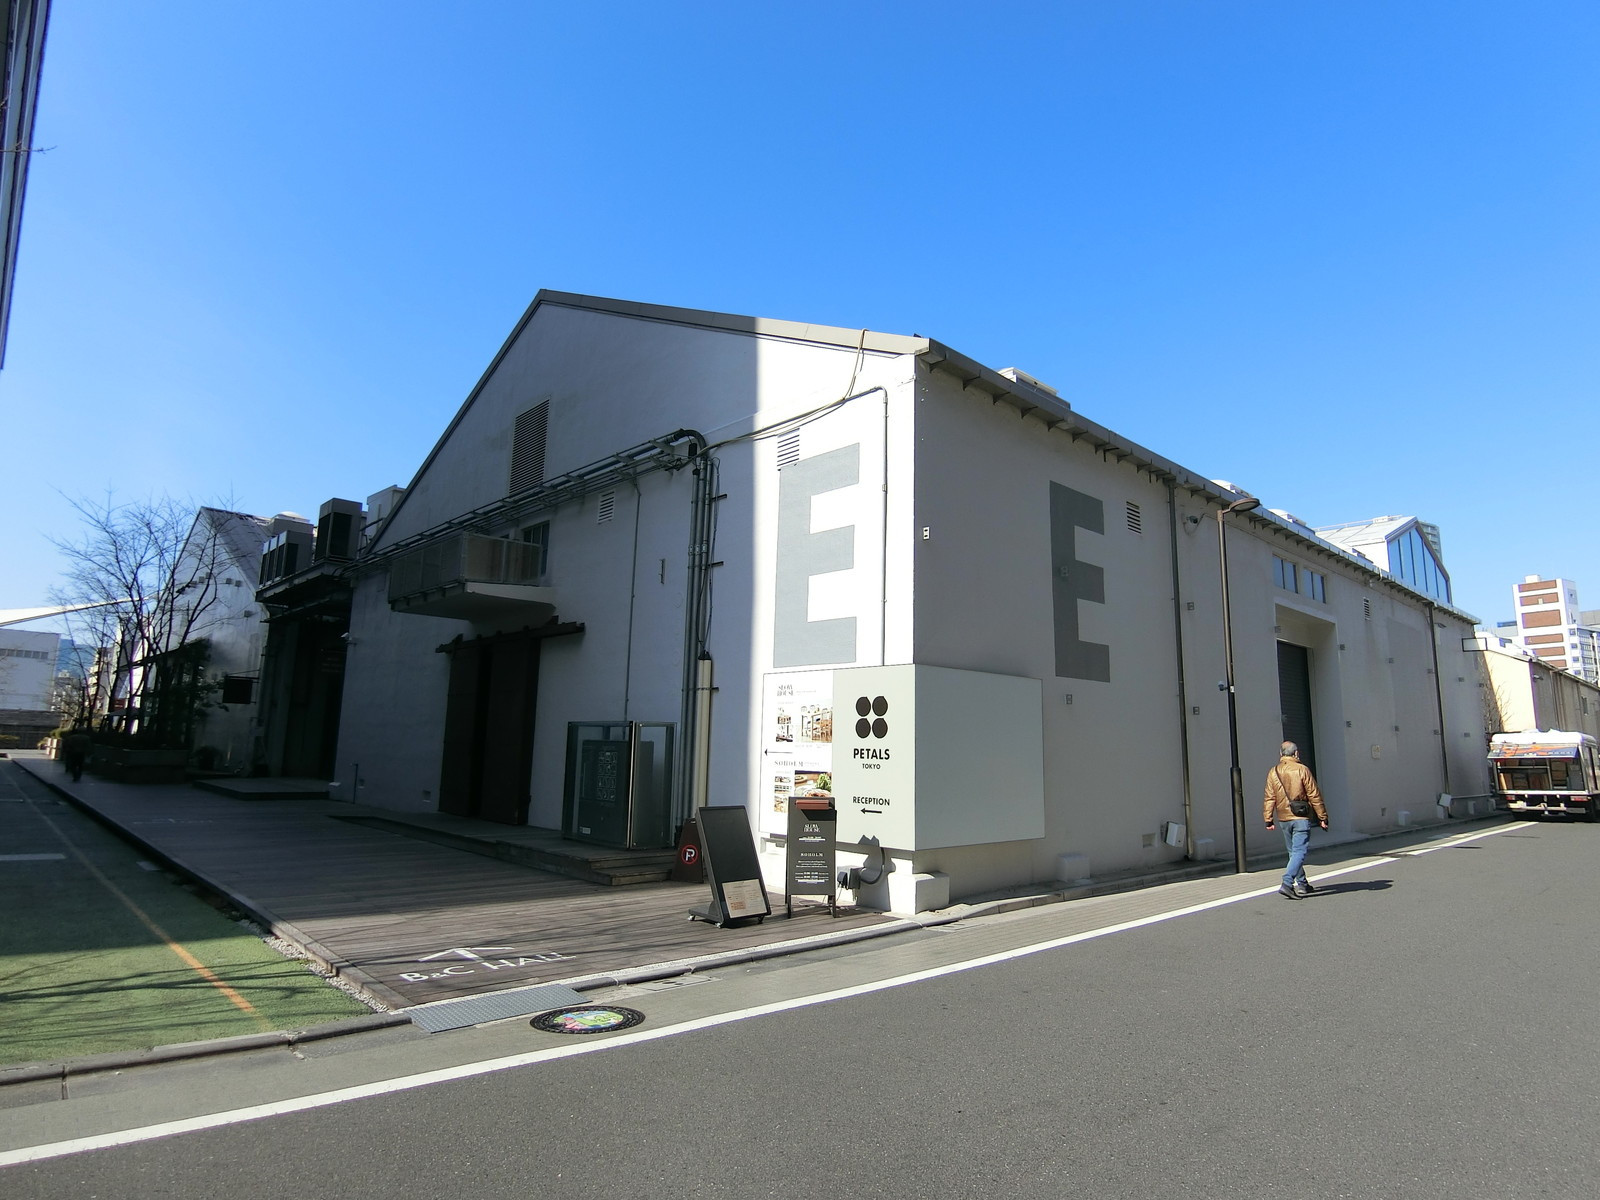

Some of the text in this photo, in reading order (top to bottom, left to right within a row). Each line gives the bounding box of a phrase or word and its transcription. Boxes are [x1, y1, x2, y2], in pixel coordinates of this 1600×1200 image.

[773, 442, 860, 669] E
[1049, 480, 1110, 683] E
[853, 748, 890, 760] PETALS
[852, 796, 890, 806] RECEPTION
[399, 952, 577, 983] B&C HALL
